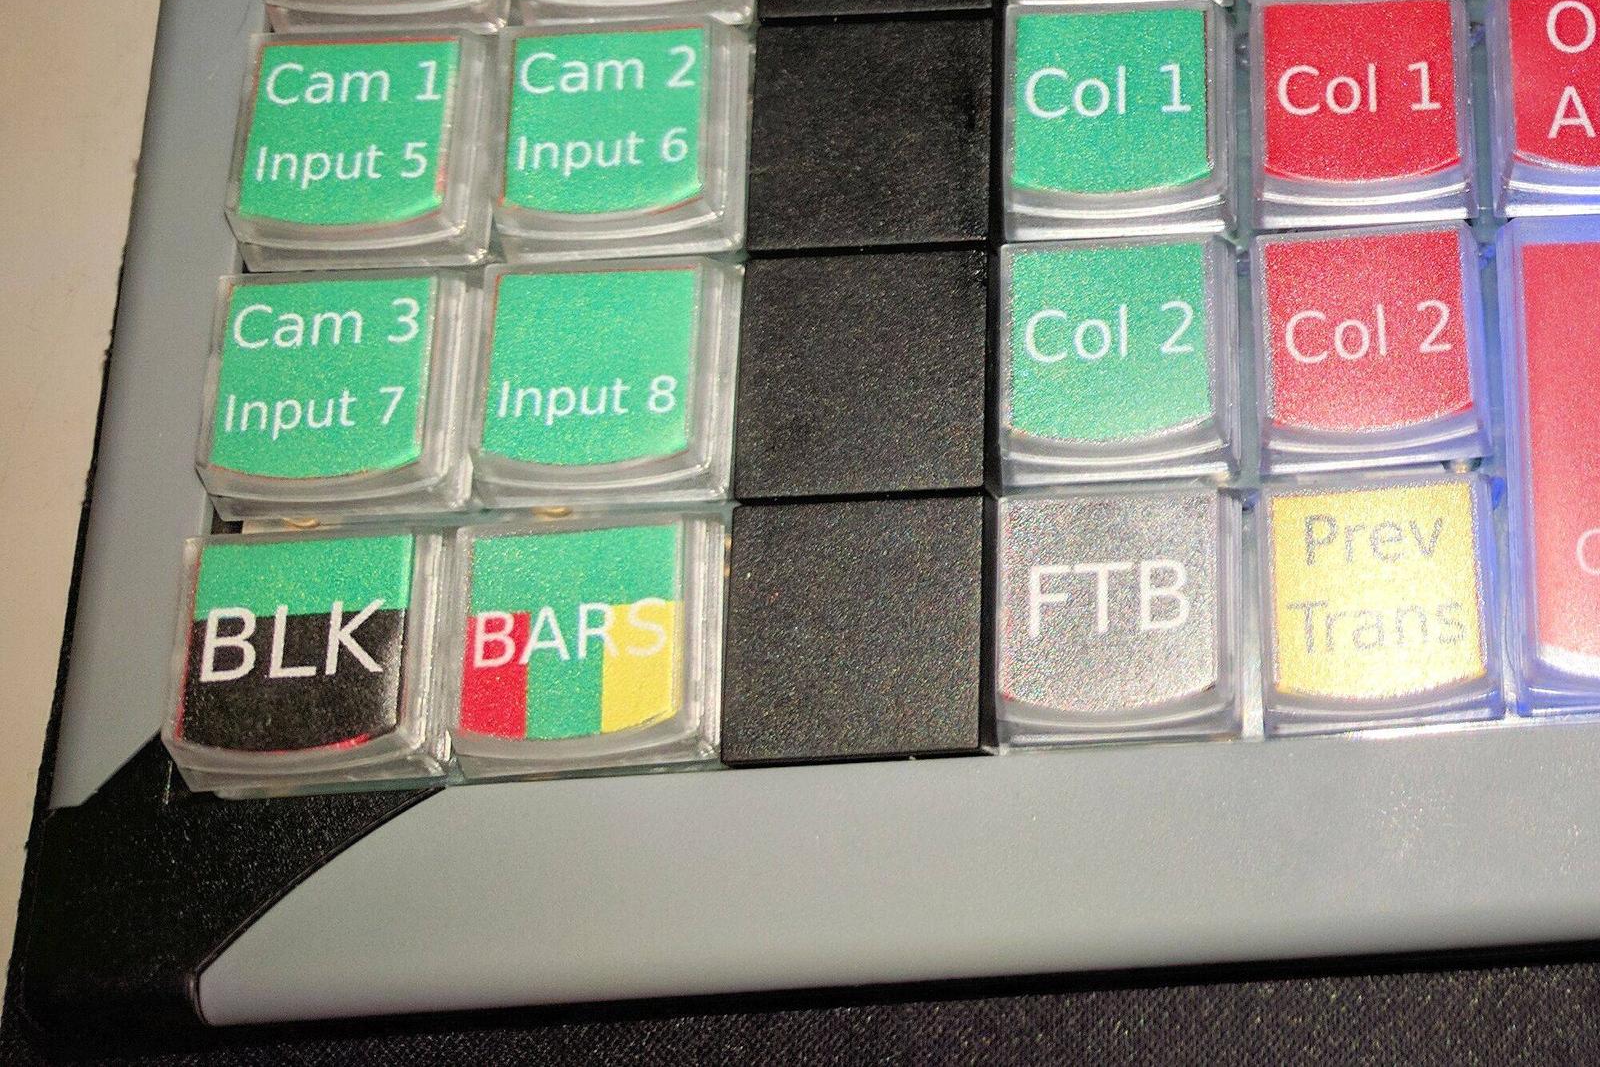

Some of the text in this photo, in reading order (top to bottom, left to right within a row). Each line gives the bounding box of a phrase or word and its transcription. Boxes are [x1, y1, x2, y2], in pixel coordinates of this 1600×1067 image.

[265, 61, 442, 106] Cam 1
[520, 46, 696, 96] Cam 2
[1025, 63, 1192, 120] Col 1
[1277, 61, 1442, 118] Col 1
[254, 141, 427, 190] Input 5
[514, 127, 688, 178] Input 6
[231, 298, 420, 350] Cam 3
[1025, 300, 1194, 364] Col 2
[1284, 300, 1453, 365] Col 2
[223, 385, 406, 440] Input 7
[497, 374, 678, 426] Input 8
[1304, 512, 1445, 566] Prev
[1027, 558, 1190, 637] FTB
[199, 598, 386, 684] BLK
[471, 598, 668, 669] BARS
[1286, 600, 1468, 655] Trans
